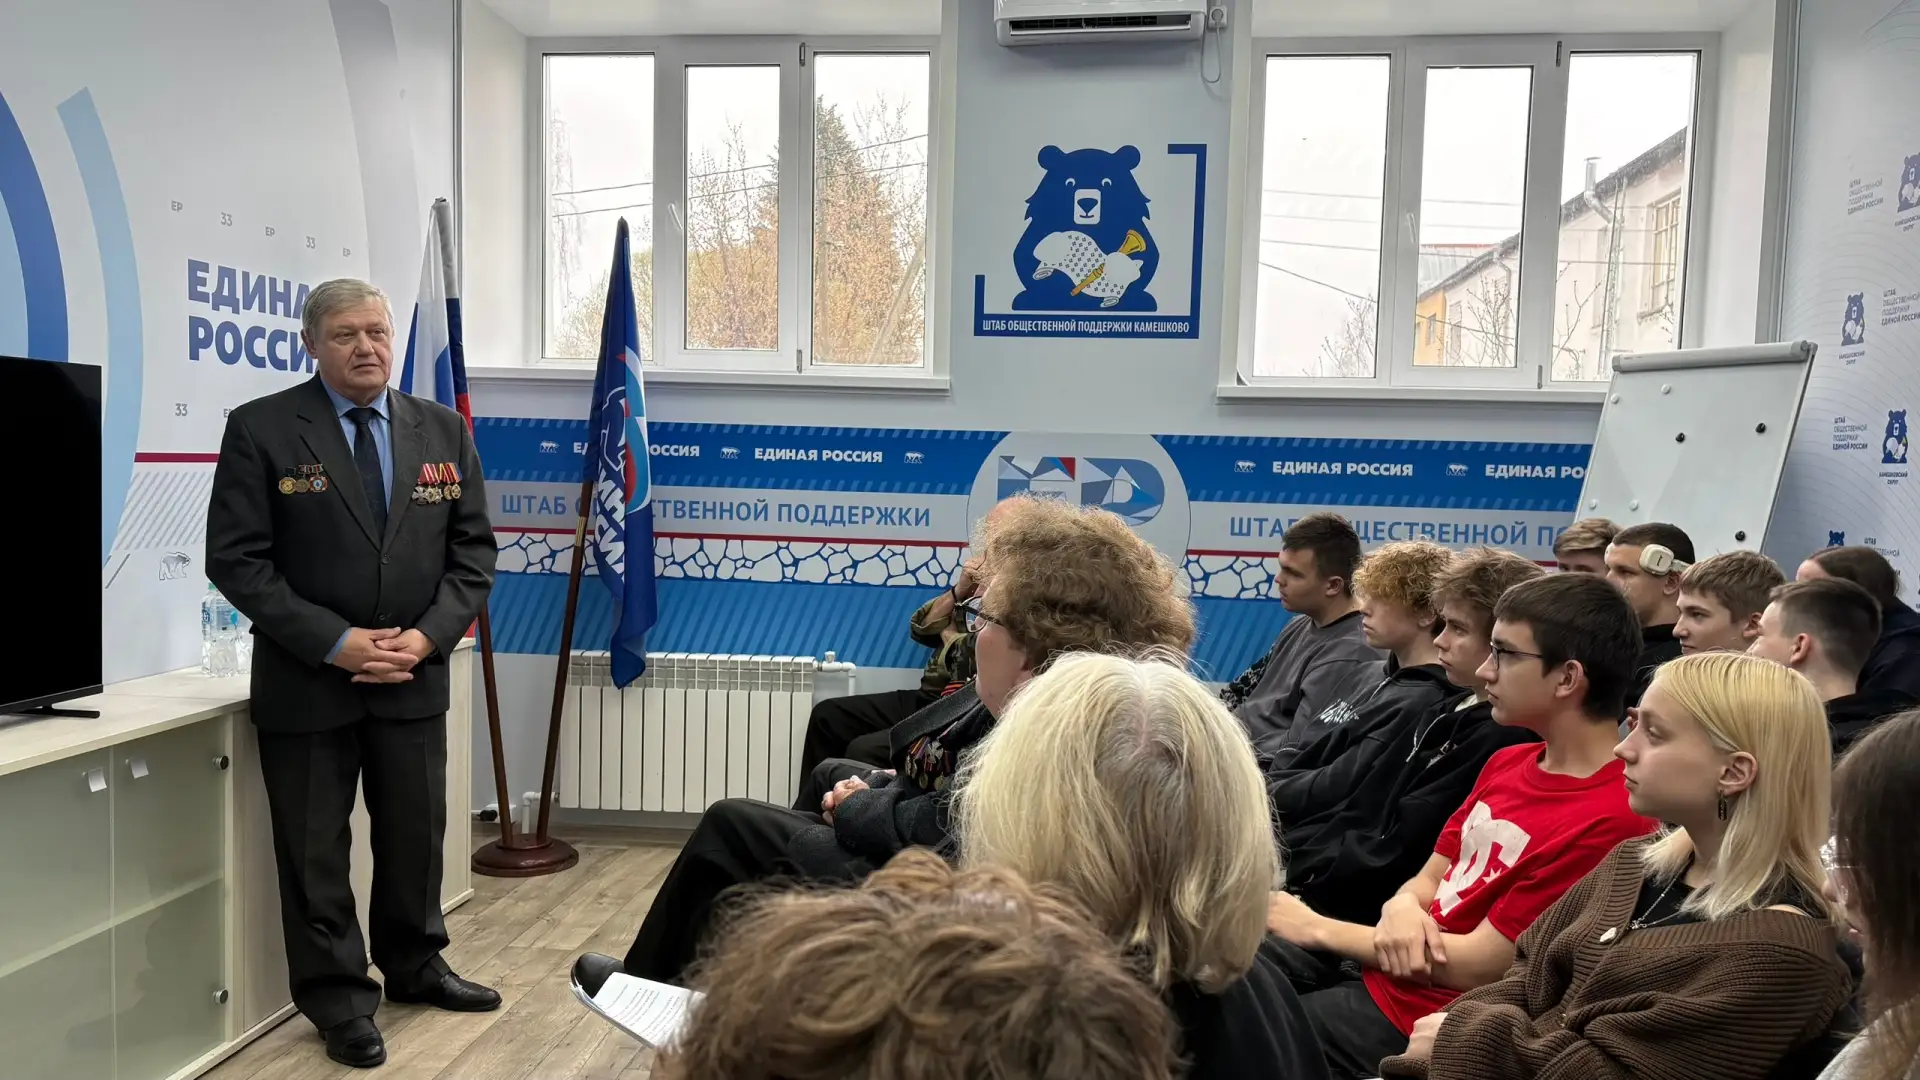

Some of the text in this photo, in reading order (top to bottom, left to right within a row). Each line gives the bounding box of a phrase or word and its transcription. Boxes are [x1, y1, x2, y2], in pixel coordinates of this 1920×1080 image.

[171, 201, 183, 212] ЕР
[220, 212, 233, 226] 33
[265, 226, 275, 237] ЕР
[306, 236, 316, 249] 33
[187, 259, 312, 319] ЕДИНА
[982, 319, 1190, 333] ШТАБ ОБЩЕСТВЕННОЙ ПОДДЕРЖКИ КАМЕШКОВО
[188, 315, 319, 375] РОССИ
[175, 403, 188, 417] 33
[649, 444, 700, 457] ОССИЯ
[755, 447, 884, 463] ЕДИНАЯ РОССИЯ
[1272, 460, 1414, 477] ЕДИНАЯ РОССИЯ
[1485, 464, 1556, 479] ЕДИНАЯ
[502, 494, 568, 516] ШТАБ
[777, 503, 931, 528] ПОДДЕРЖКИ
